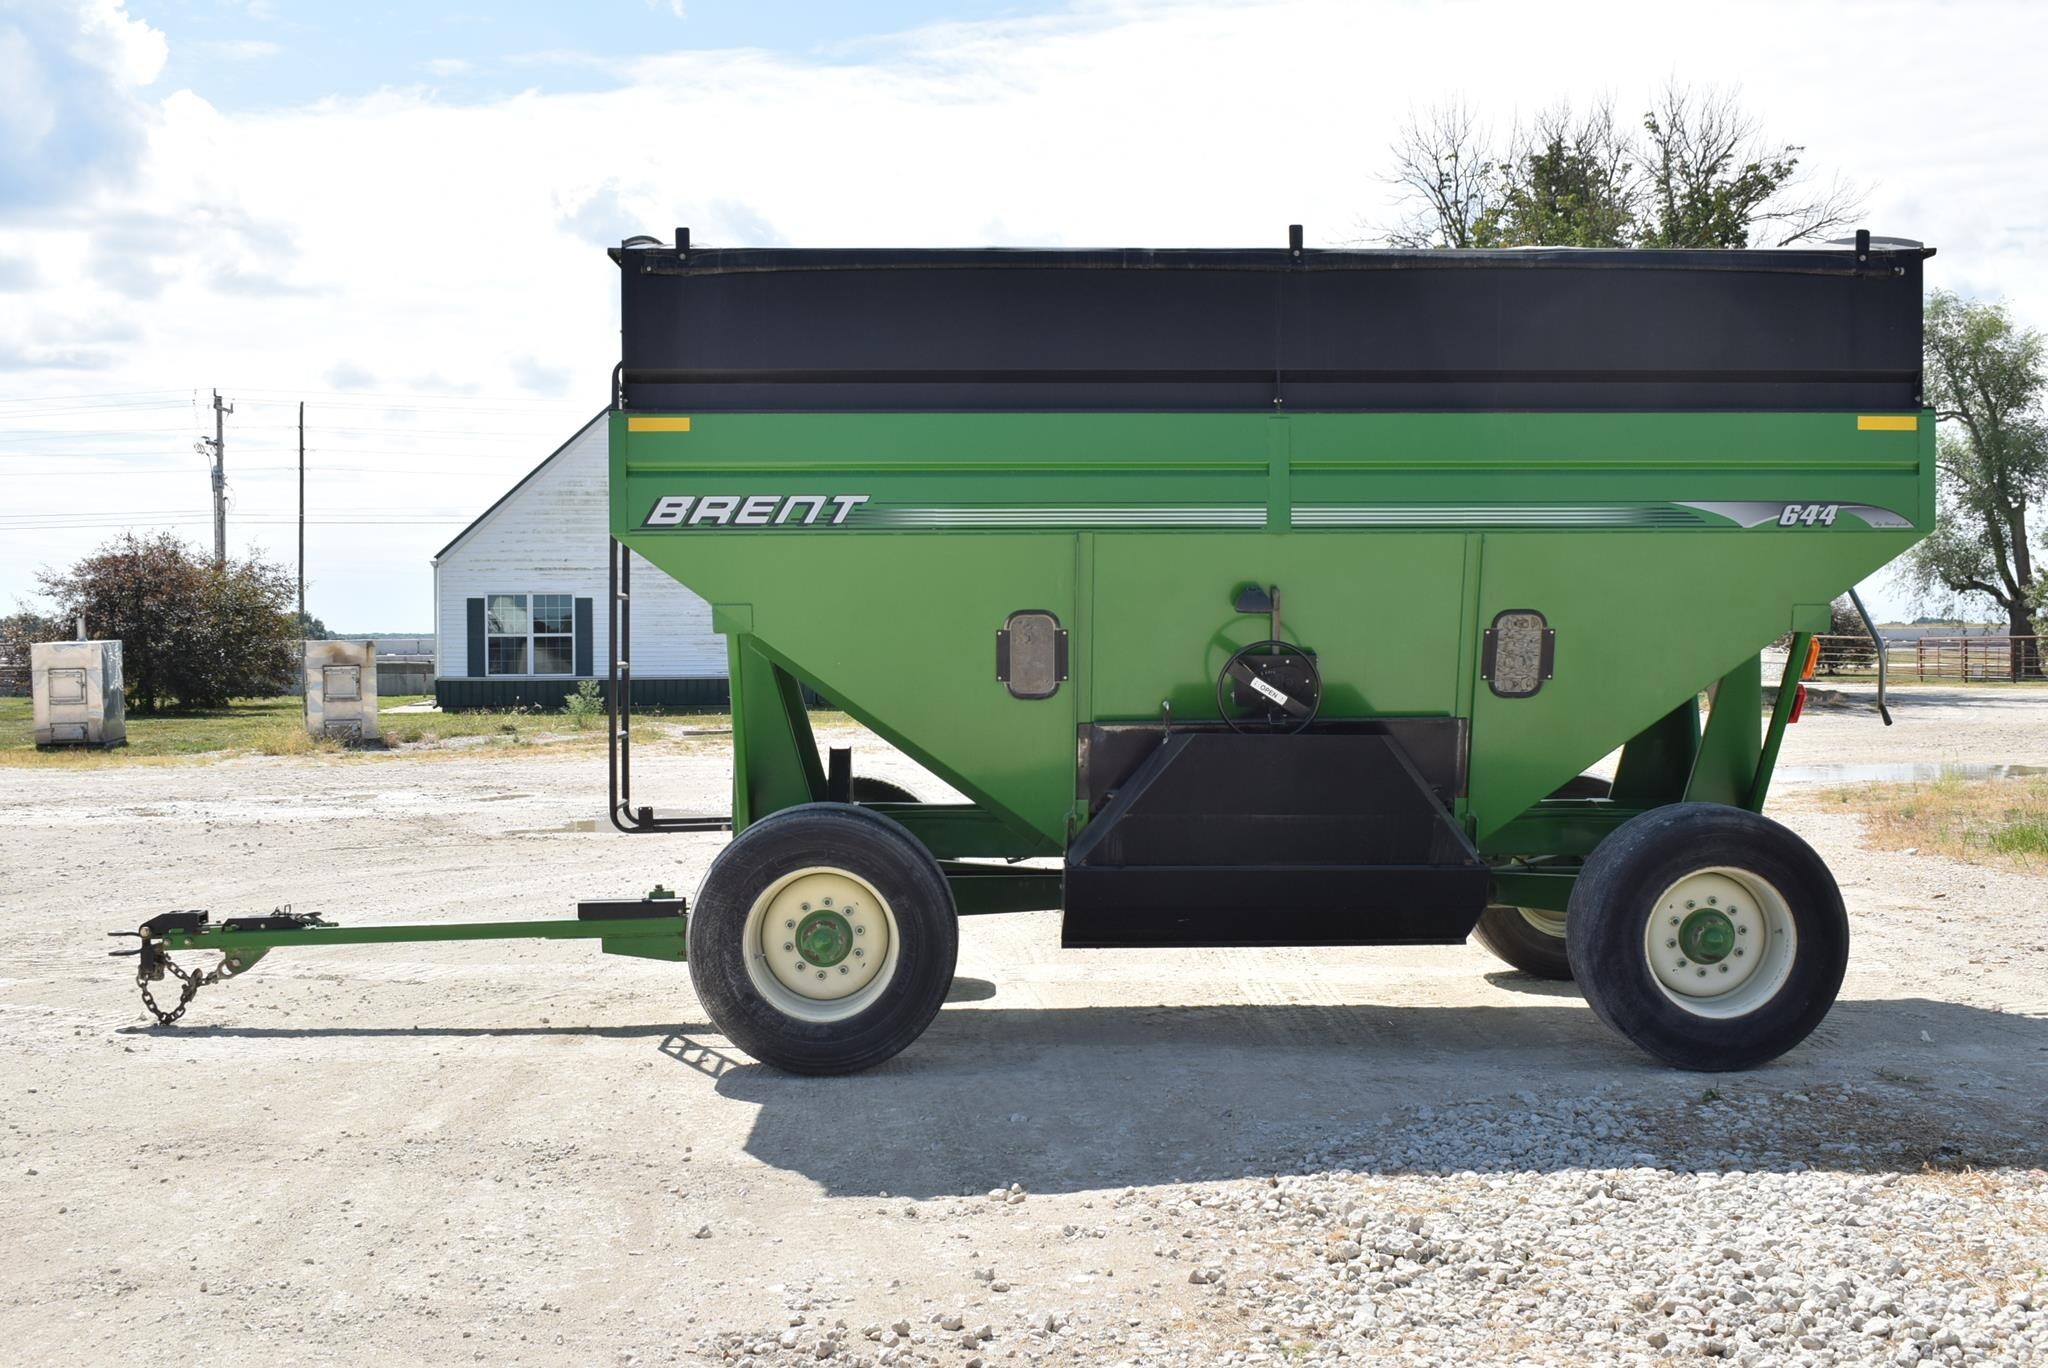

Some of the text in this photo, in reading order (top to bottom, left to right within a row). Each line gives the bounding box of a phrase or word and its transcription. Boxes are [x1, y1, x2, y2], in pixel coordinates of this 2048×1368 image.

[644, 495, 871, 526] BRENT
[1778, 504, 1839, 526] 644
[1260, 684, 1279, 699] OPEN
